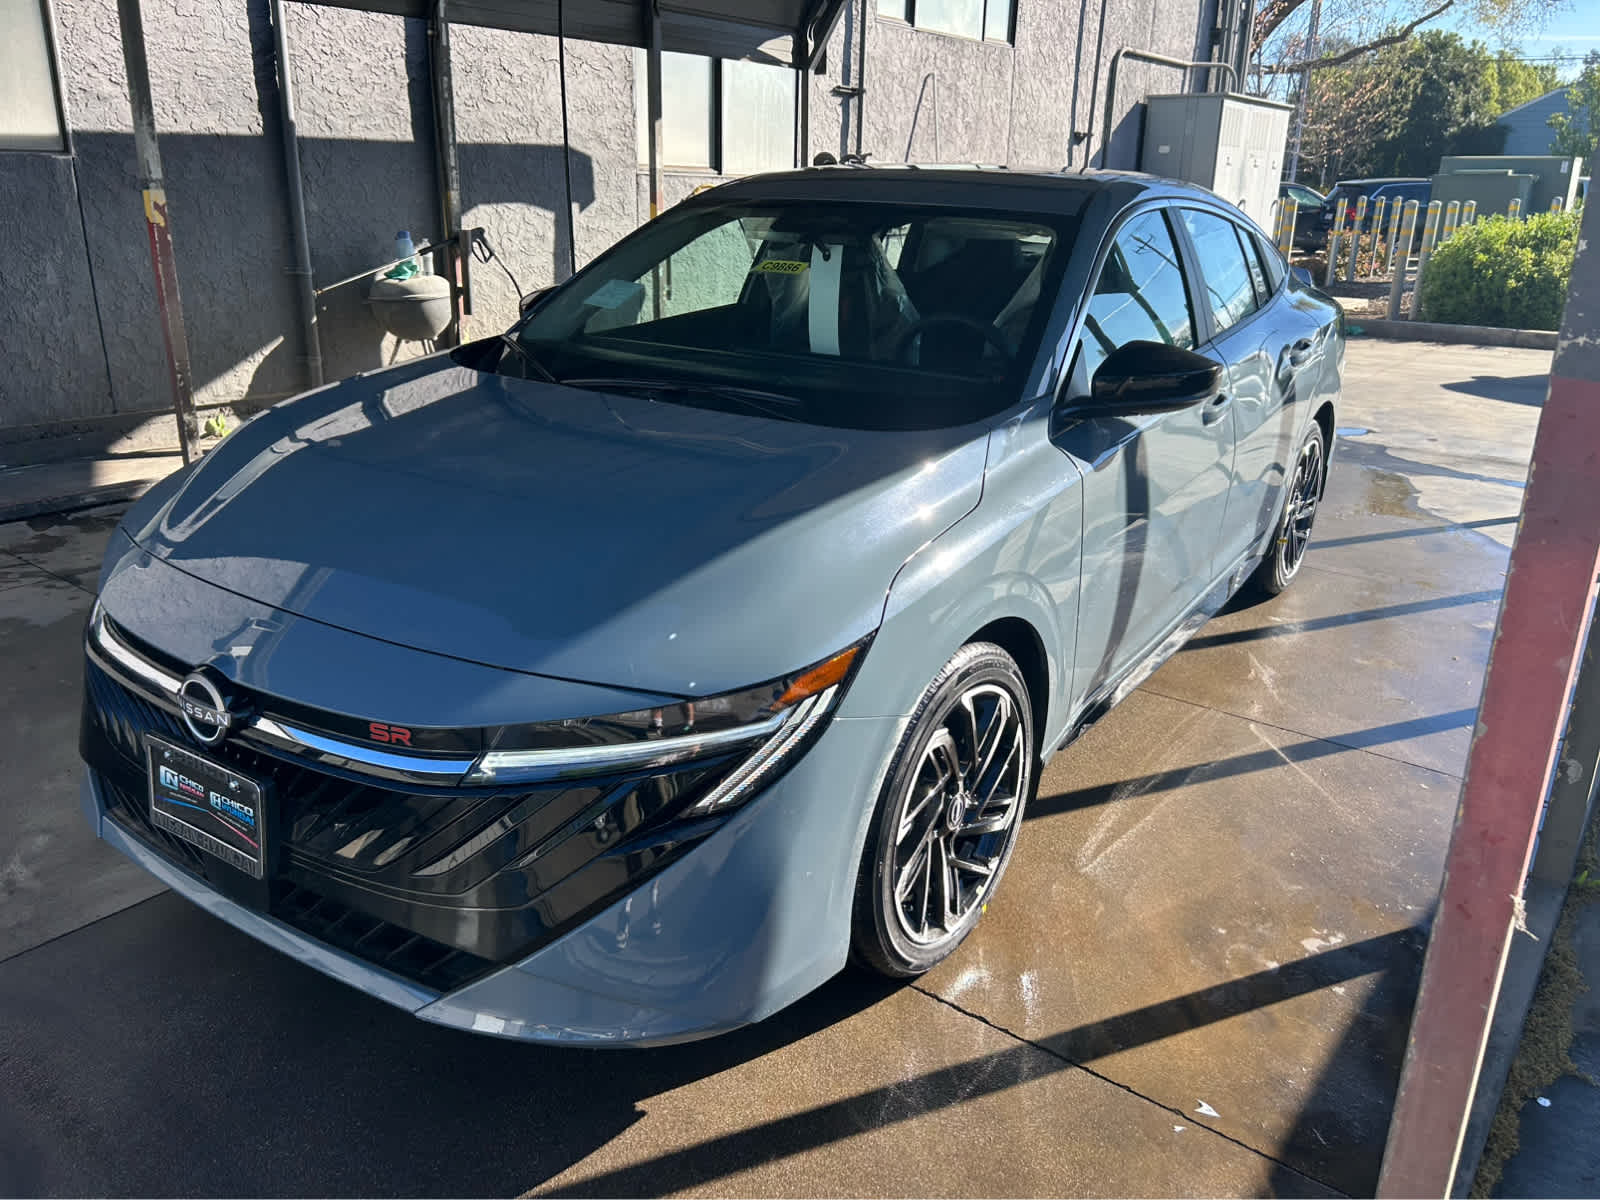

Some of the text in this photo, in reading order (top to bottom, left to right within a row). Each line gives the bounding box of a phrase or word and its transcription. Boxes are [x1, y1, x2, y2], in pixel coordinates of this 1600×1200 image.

[177, 694, 228, 726] NISSAN
[369, 722, 412, 747] SR
[178, 774, 204, 793] CHICO
[221, 796, 254, 817] CHICO
